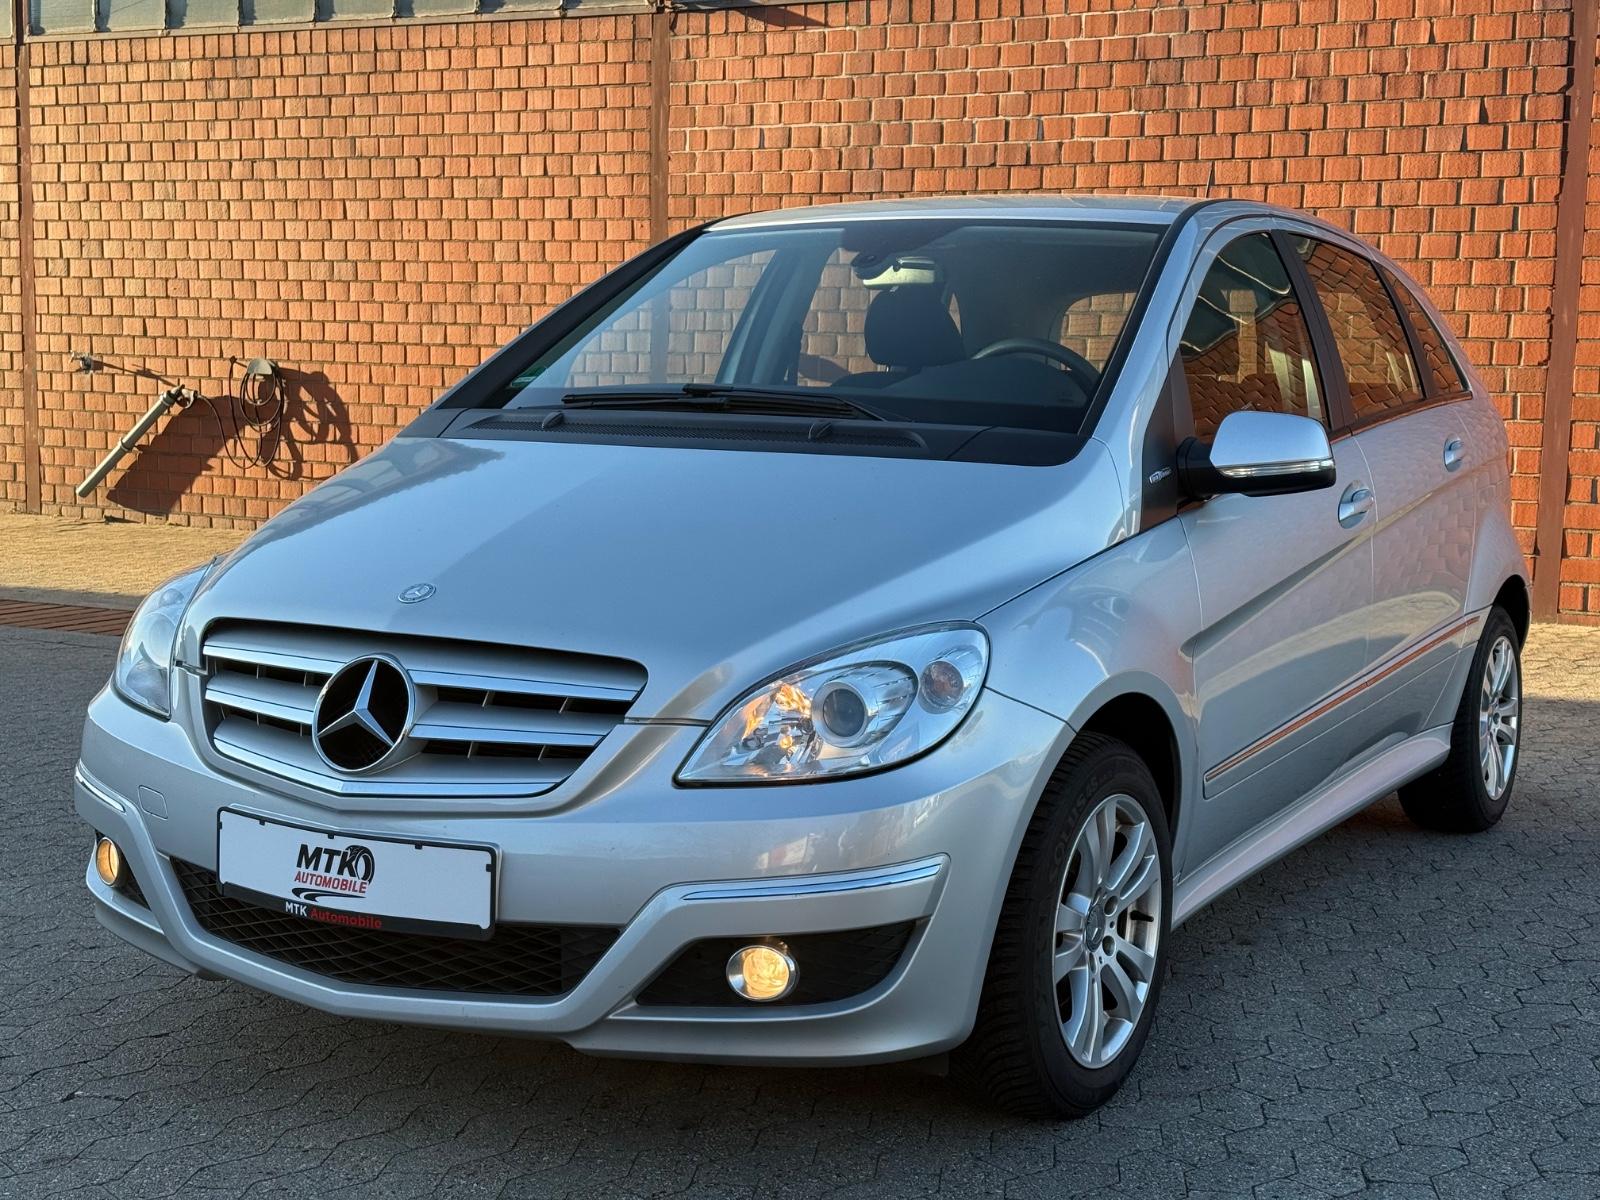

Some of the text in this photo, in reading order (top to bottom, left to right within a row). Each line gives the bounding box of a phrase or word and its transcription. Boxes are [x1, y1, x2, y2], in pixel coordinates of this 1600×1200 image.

[296, 844, 357, 877] MTK
[294, 871, 367, 893] AUTOMOBILE
[285, 901, 382, 928] MTK Automobile
